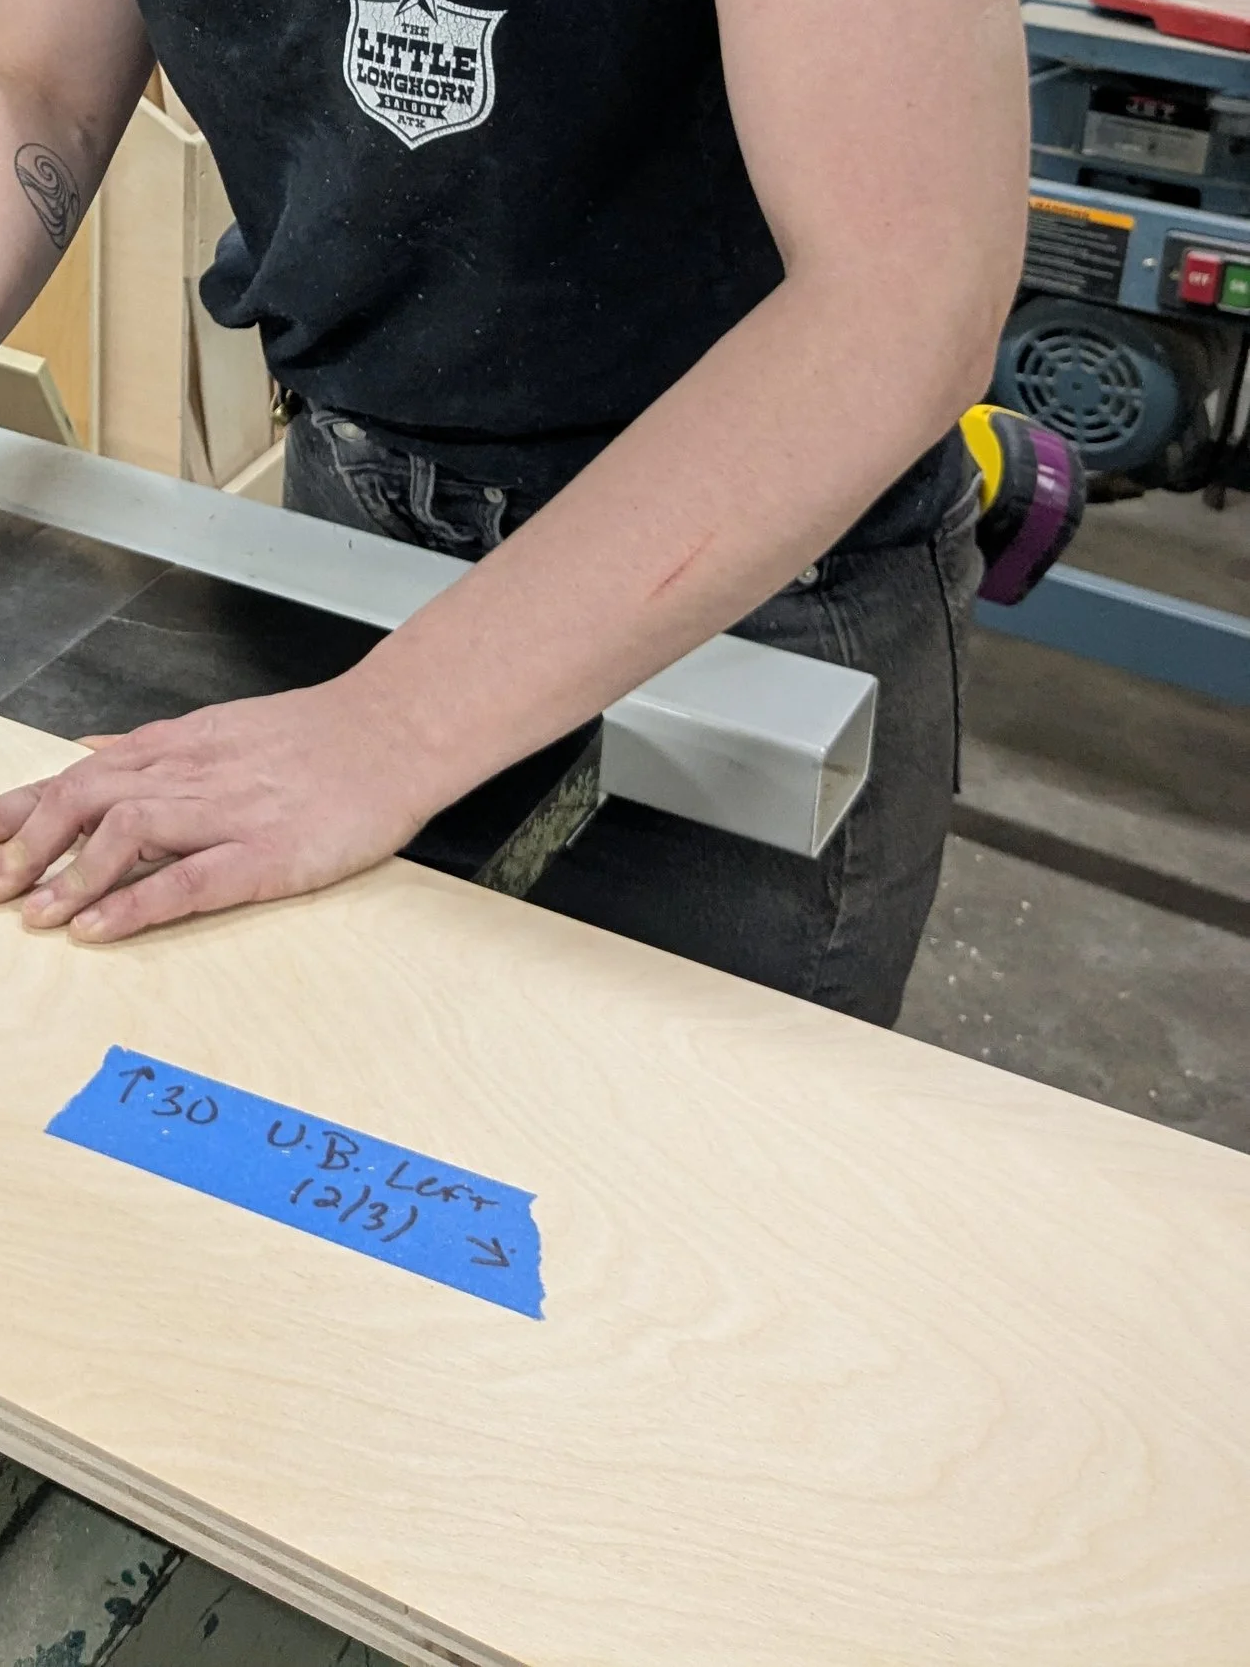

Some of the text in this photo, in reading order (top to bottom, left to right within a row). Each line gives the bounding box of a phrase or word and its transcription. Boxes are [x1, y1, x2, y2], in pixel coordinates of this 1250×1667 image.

[400, 22, 430, 38] THE
[356, 27, 479, 82] LITTLE
[356, 62, 475, 107] LONGHORN
[384, 95, 439, 117] SALOON
[396, 114, 426, 129] ATX
[151, 1084, 220, 1126] 30
